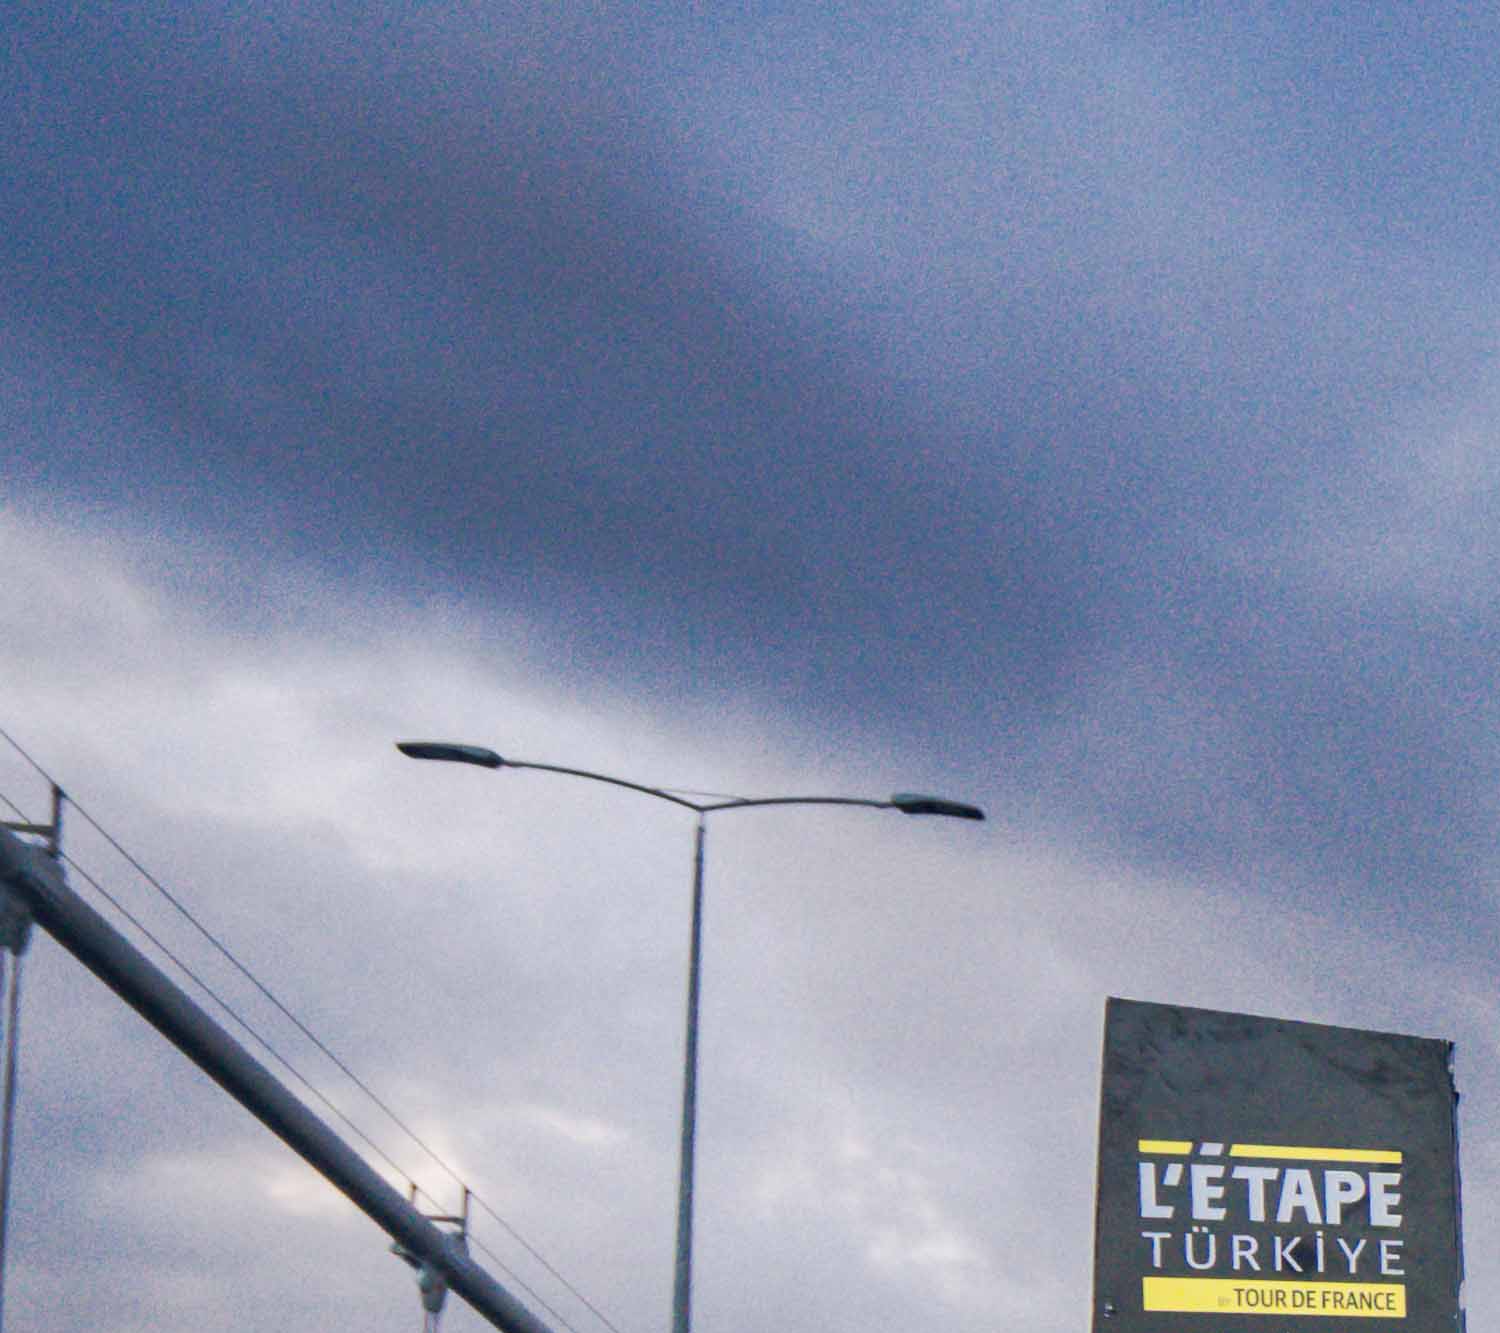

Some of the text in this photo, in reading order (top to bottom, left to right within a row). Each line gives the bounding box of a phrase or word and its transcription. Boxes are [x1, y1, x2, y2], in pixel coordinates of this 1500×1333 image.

[1138, 1142, 1403, 1227] L'ÉTAPE
[1141, 1226, 1405, 1276] TÜRKİYE
[1233, 1288, 1288, 1308] TOUR
[1291, 1289, 1317, 1309] DE
[1321, 1290, 1397, 1311] FRANCE
